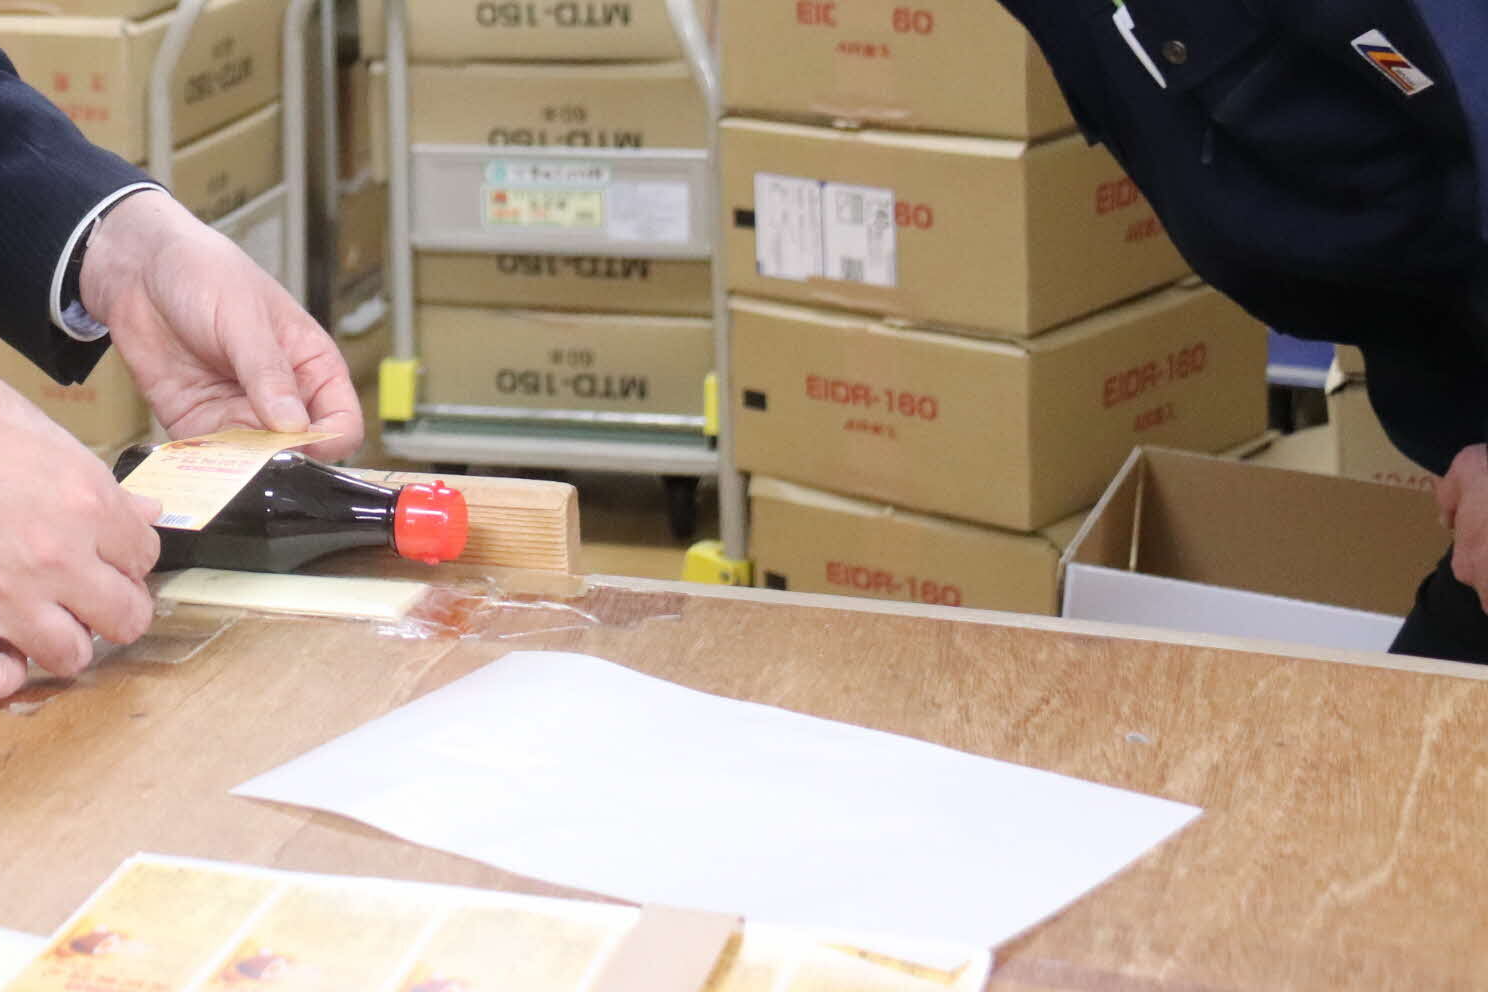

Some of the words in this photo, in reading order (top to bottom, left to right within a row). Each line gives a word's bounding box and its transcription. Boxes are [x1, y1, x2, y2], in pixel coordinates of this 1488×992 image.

[475, 1, 632, 29] MTD-150
[496, 369, 650, 402] MTD-150
[805, 374, 939, 421] EIDR-160
[825, 559, 962, 608] EIDR-160
